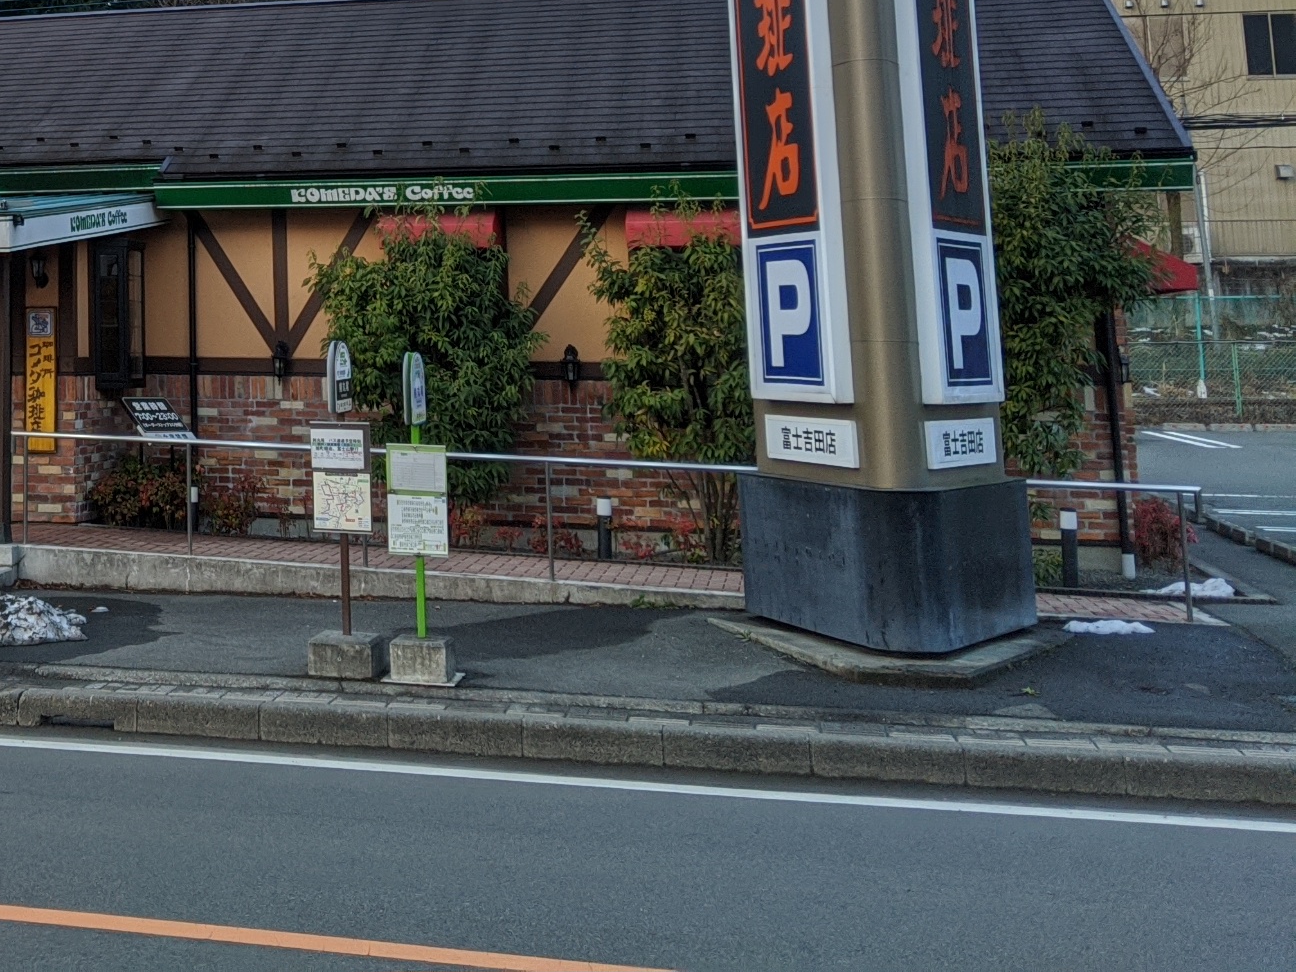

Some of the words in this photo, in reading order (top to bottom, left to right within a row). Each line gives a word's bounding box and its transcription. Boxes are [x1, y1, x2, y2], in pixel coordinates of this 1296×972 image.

[290, 186, 398, 203] KOMEDA'S
[405, 184, 475, 201] Coffee
[70, 212, 106, 233] KOMEDA'S
[107, 209, 128, 227] Coffee
[765, 259, 812, 368] P
[945, 257, 982, 370] P
[781, 425, 837, 456] 富士吉田店
[942, 428, 984, 458] 富士吉田店
